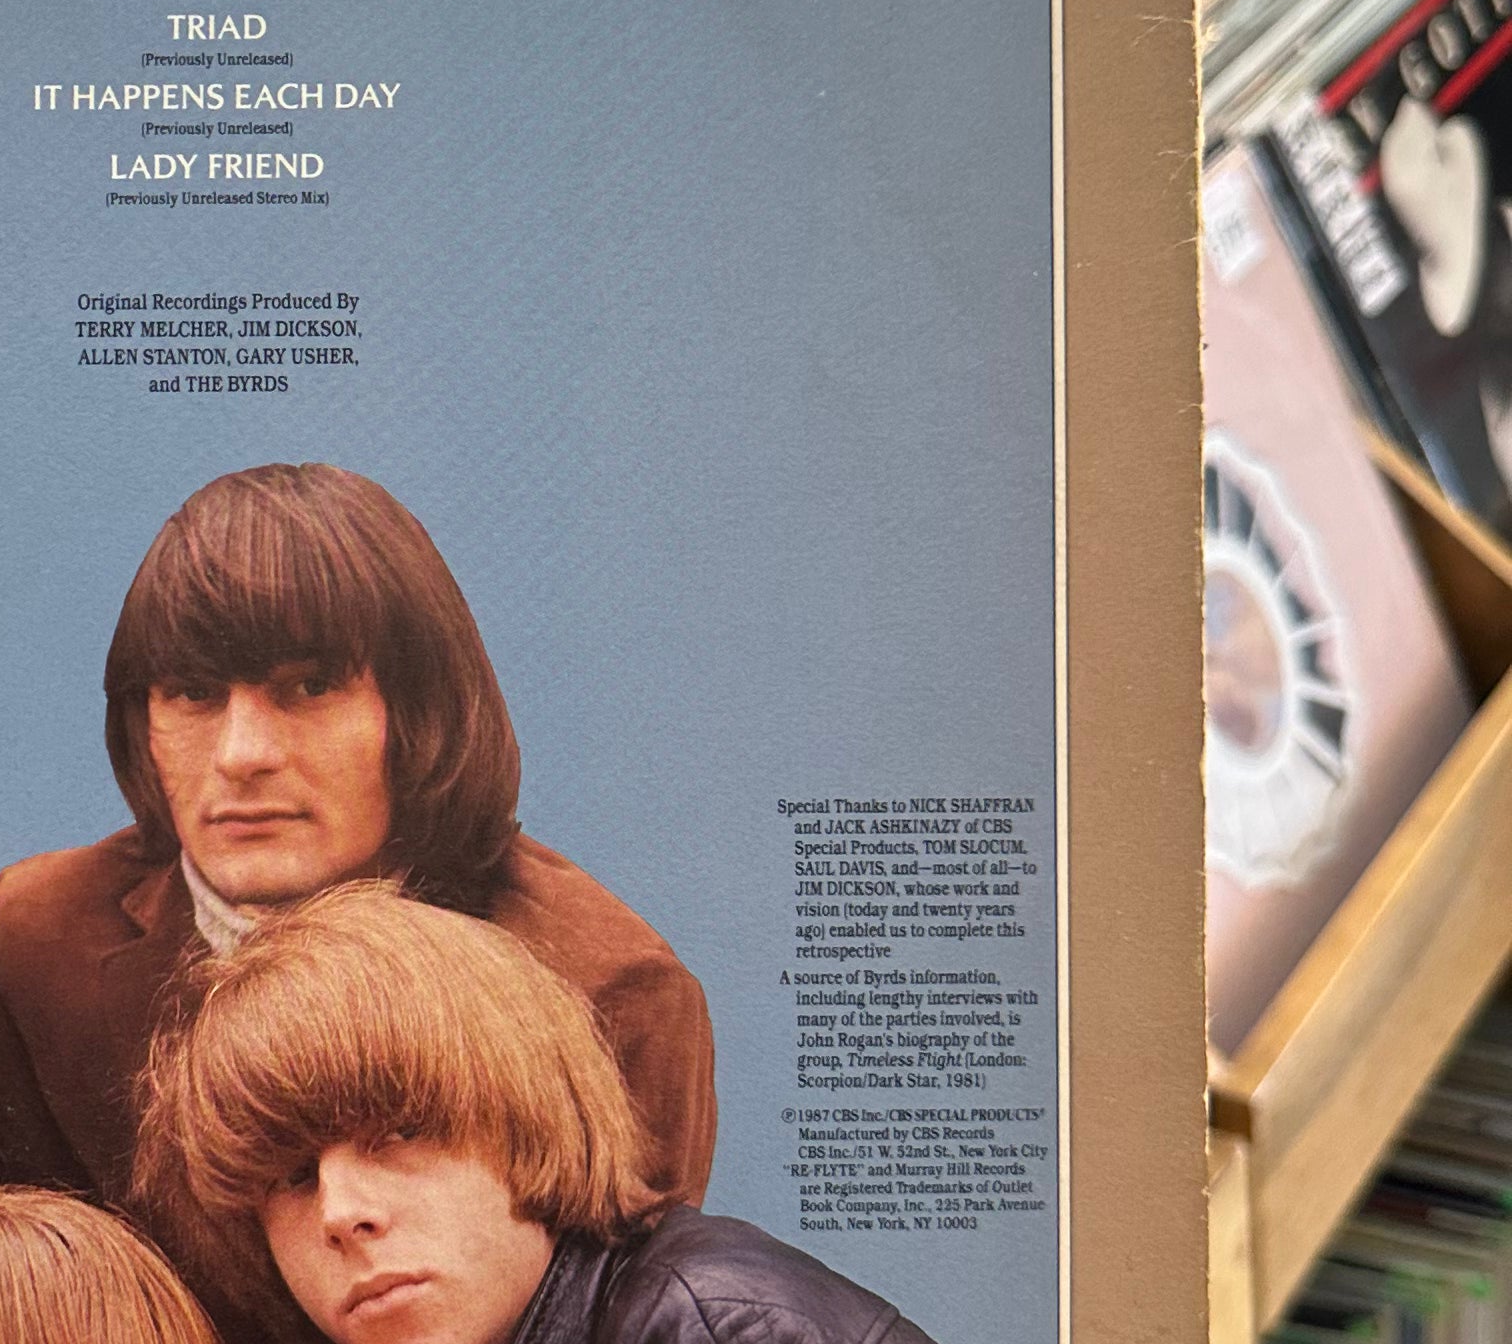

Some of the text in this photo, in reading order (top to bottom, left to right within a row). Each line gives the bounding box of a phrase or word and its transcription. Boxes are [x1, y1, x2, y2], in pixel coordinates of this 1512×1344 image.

[166, 14, 267, 40] TRIAD
[141, 52, 294, 70] (Previously Unreleased)
[34, 82, 401, 111] IT HAPPENS EACH DAY
[141, 121, 294, 139] (Previously Unreleased)
[111, 153, 325, 180] LADY FRIEND
[105, 191, 330, 209] (Previously Unreleased Stereo Mix)
[77, 292, 360, 316] Original Recordings Produced By
[74, 319, 362, 339] TERRY MELCHER, JIM DICKSON,
[77, 347, 359, 367] ALLEN STANTON, GARY USHER,
[148, 375, 289, 393] and THE BYRDS
[777, 797, 1035, 818] Special Thanks to NICK SHAFFRAN
[794, 818, 1013, 835] and JACK ASHKINAZY of CBS
[794, 880, 1020, 898] JIM DICKSON, whose work and
[796, 1031, 1015, 1052] John Rogan's biography of the
